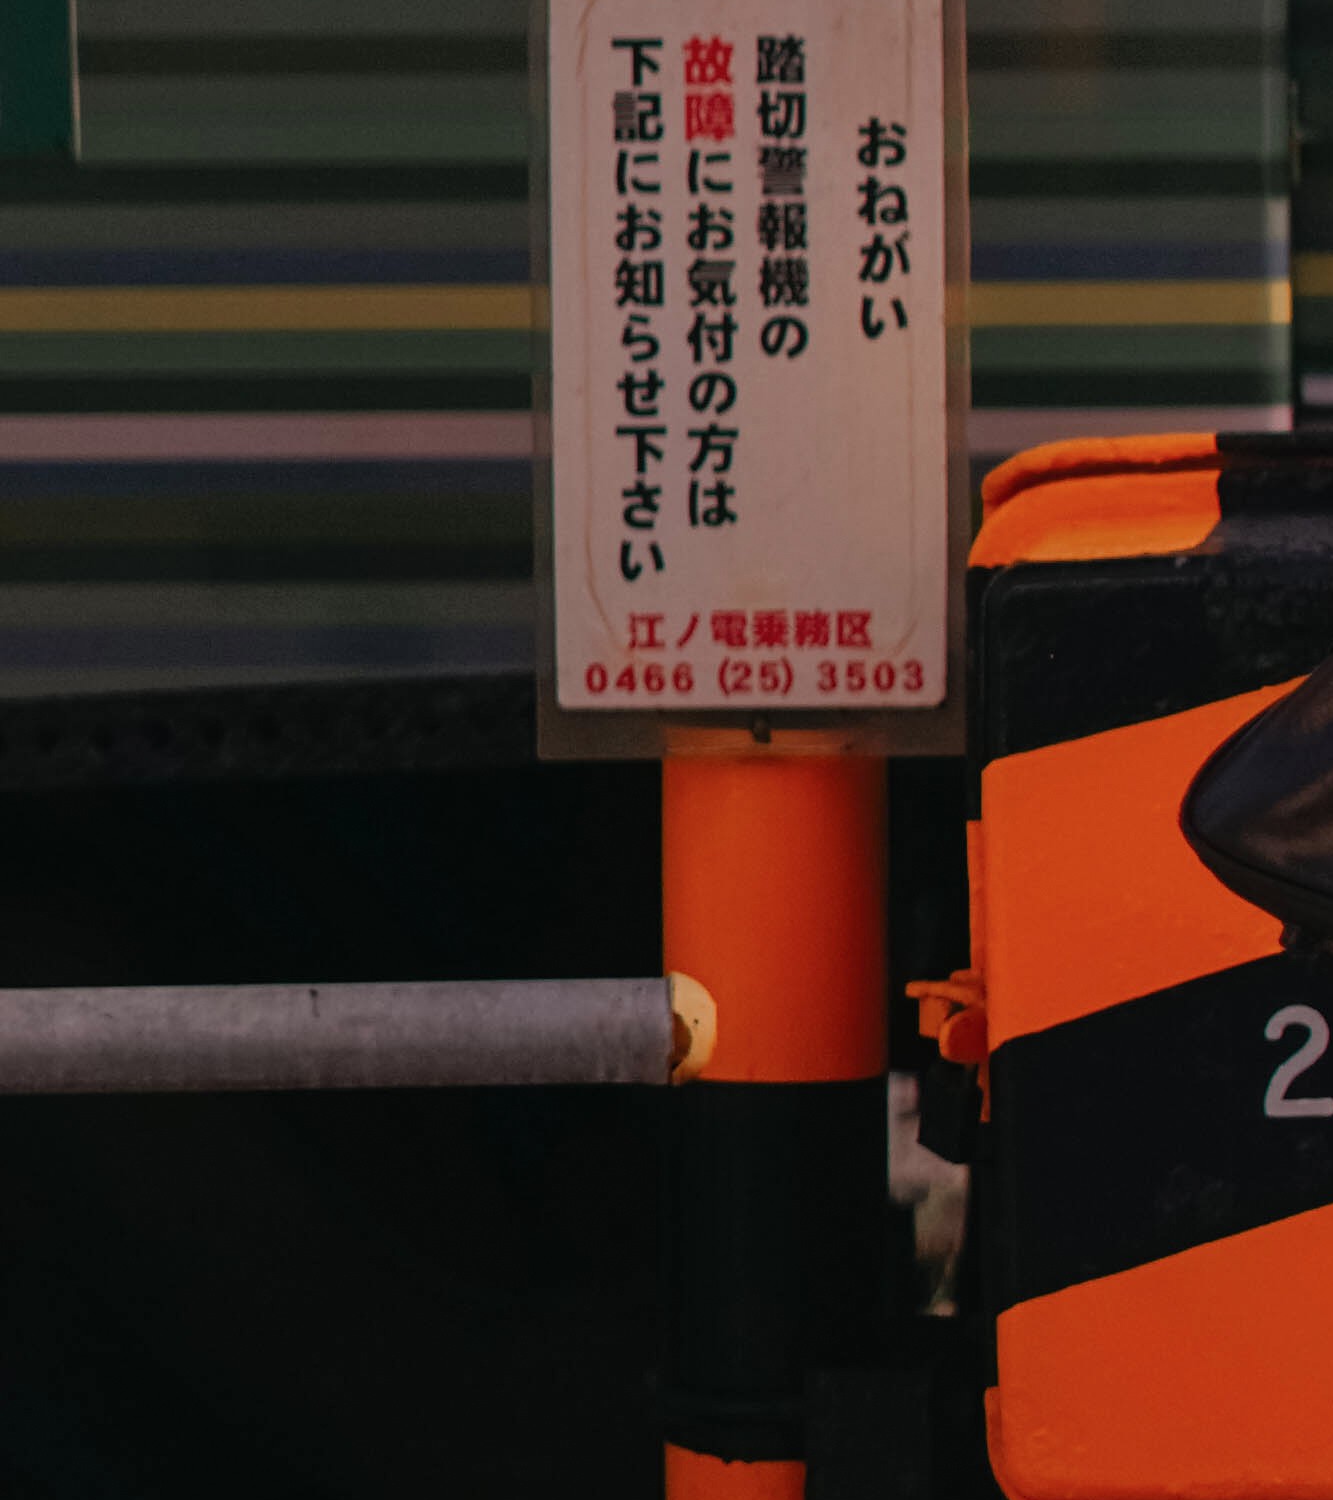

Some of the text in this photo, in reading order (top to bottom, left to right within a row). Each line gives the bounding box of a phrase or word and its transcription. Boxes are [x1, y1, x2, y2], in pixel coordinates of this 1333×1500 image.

[611, 37, 668, 584] 下記にお知らせ下さい
[682, 35, 738, 529] 故障にお気付の方は
[756, 34, 810, 360] 踏切警報機の
[856, 117, 911, 340] おねがい
[584, 656, 925, 697] 0466 (25) 3503
[627, 609, 873, 651] 江ノ電乗務区
